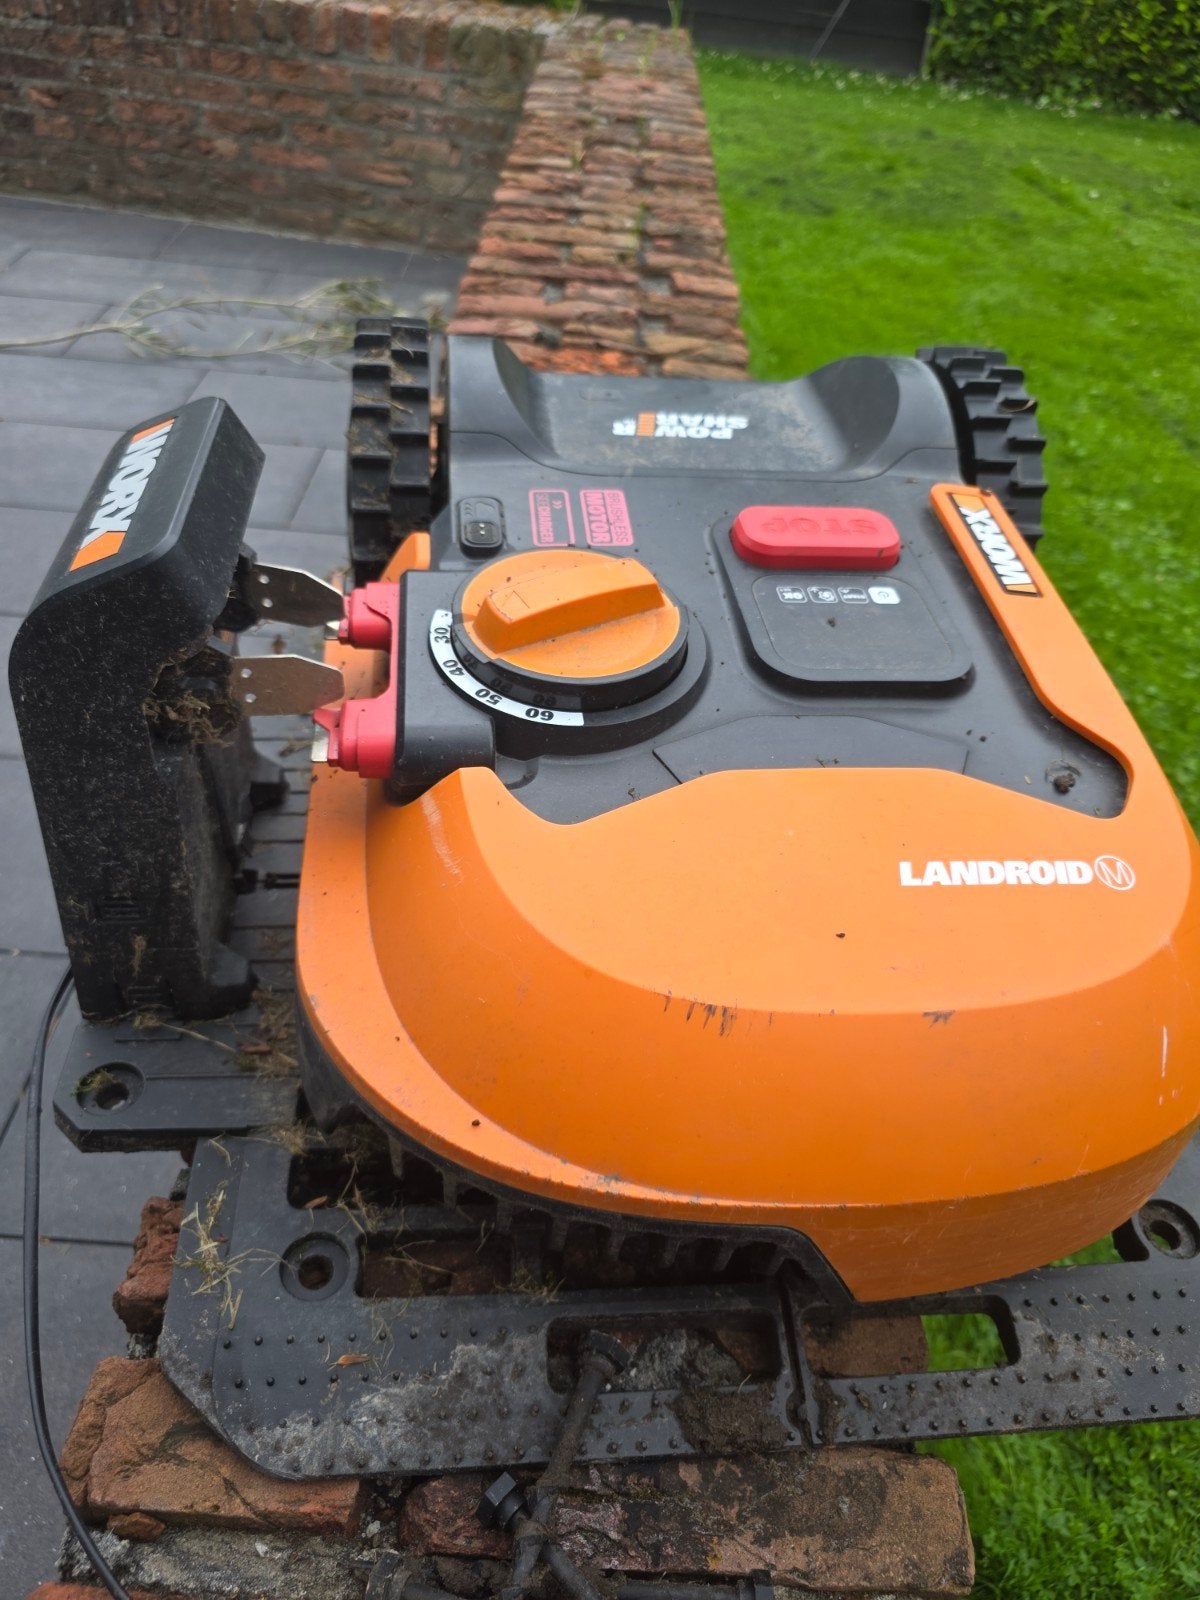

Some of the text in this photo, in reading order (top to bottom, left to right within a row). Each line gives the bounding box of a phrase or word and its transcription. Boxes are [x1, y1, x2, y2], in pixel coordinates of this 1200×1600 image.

[80, 424, 173, 549] WORX
[585, 492, 612, 543] MOTOR
[607, 492, 629, 543] BRUSHLESS
[761, 517, 879, 535] STOP
[959, 507, 1033, 585] WORX
[434, 627, 450, 644] 30
[443, 659, 465, 677] 40
[475, 688, 503, 706] 50
[525, 707, 555, 722] 60
[898, 858, 1133, 889] LANDROID M
